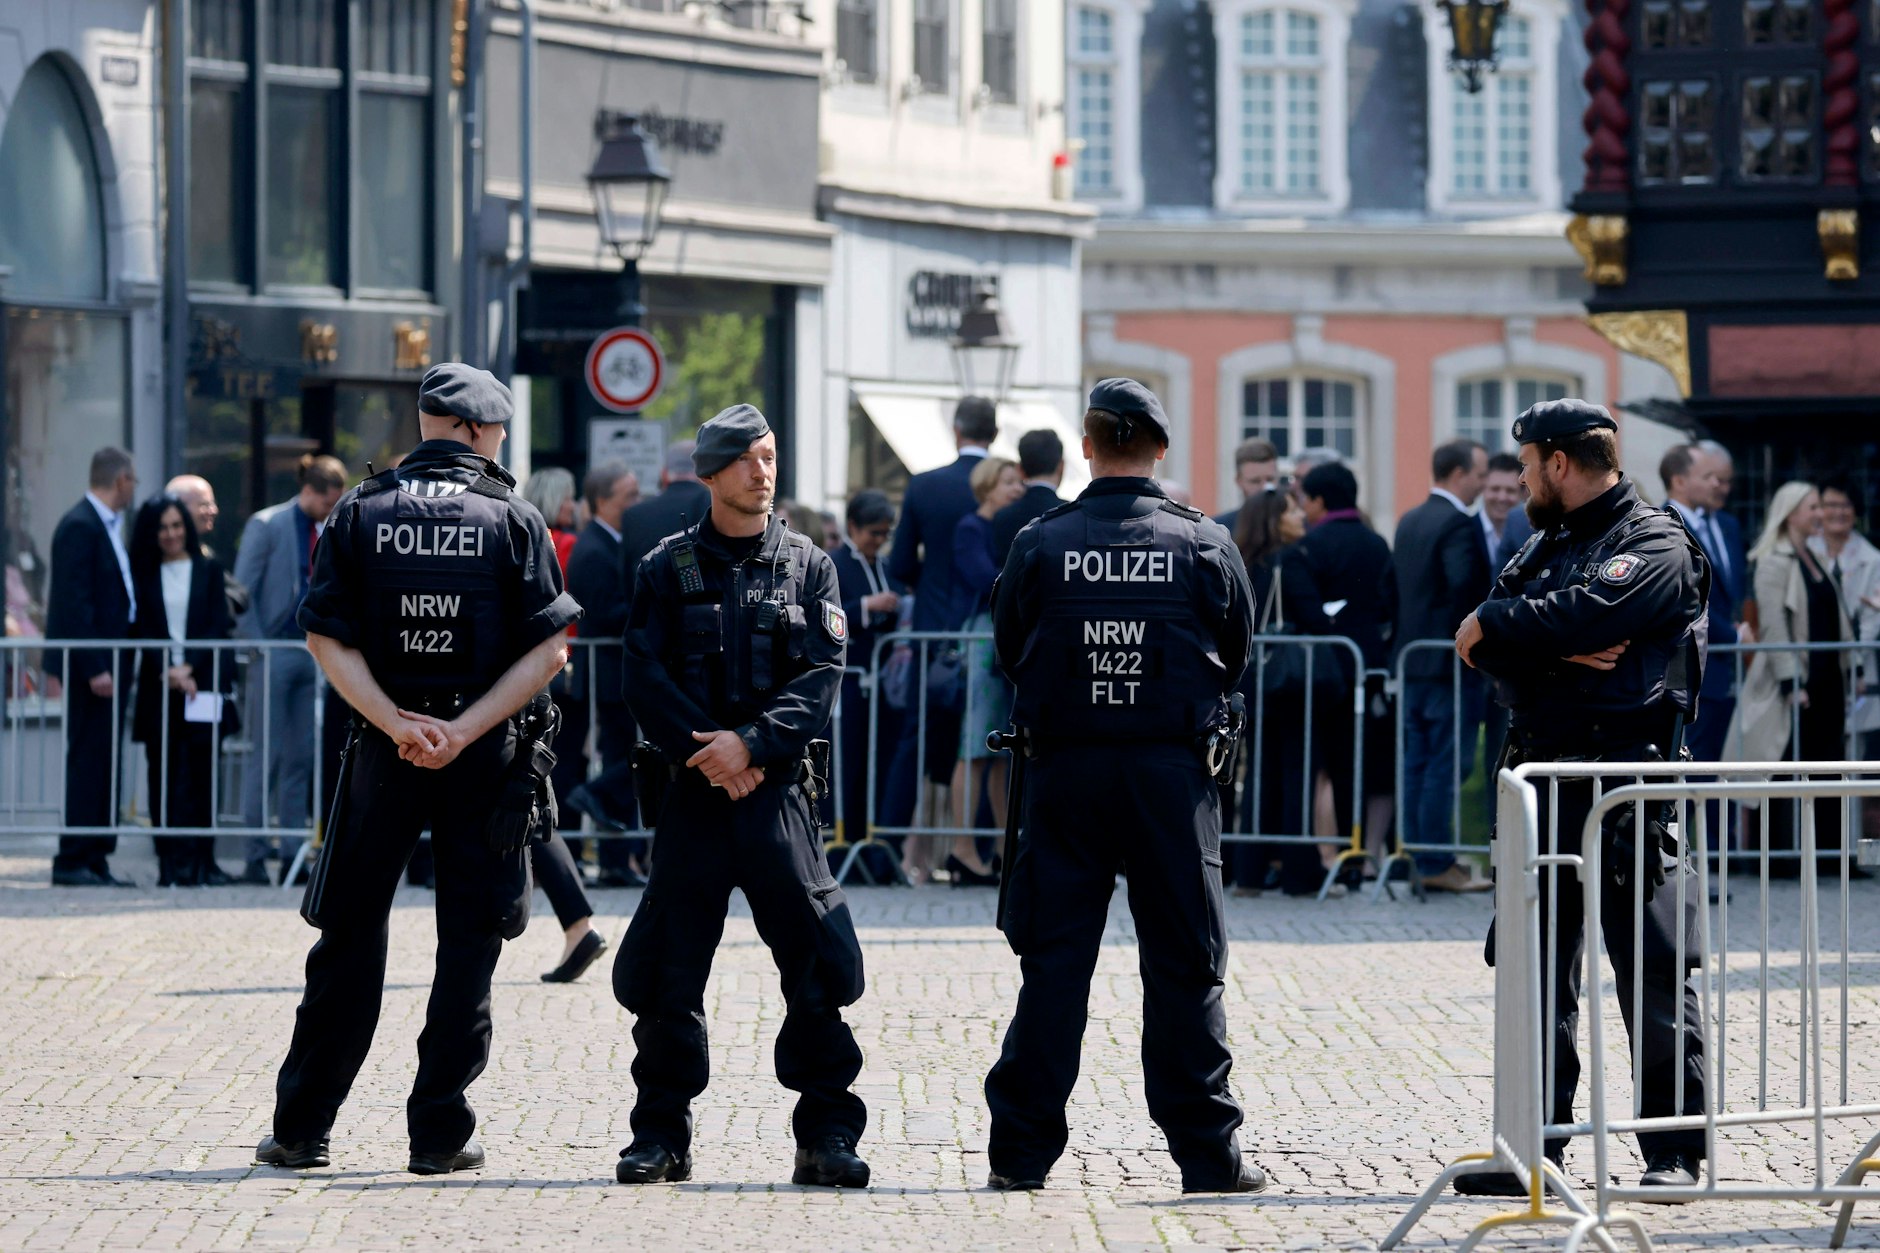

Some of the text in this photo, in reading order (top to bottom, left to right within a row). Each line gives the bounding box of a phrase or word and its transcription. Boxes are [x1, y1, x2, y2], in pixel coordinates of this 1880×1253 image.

[376, 523, 484, 557] POLIZEI
[1064, 550, 1173, 582] POLIZEI
[401, 594, 461, 617] NRW
[399, 629, 453, 653] 1422
[1084, 621, 1146, 645] NRW
[1087, 651, 1142, 675] 1422
[1091, 681, 1141, 705] FLT
